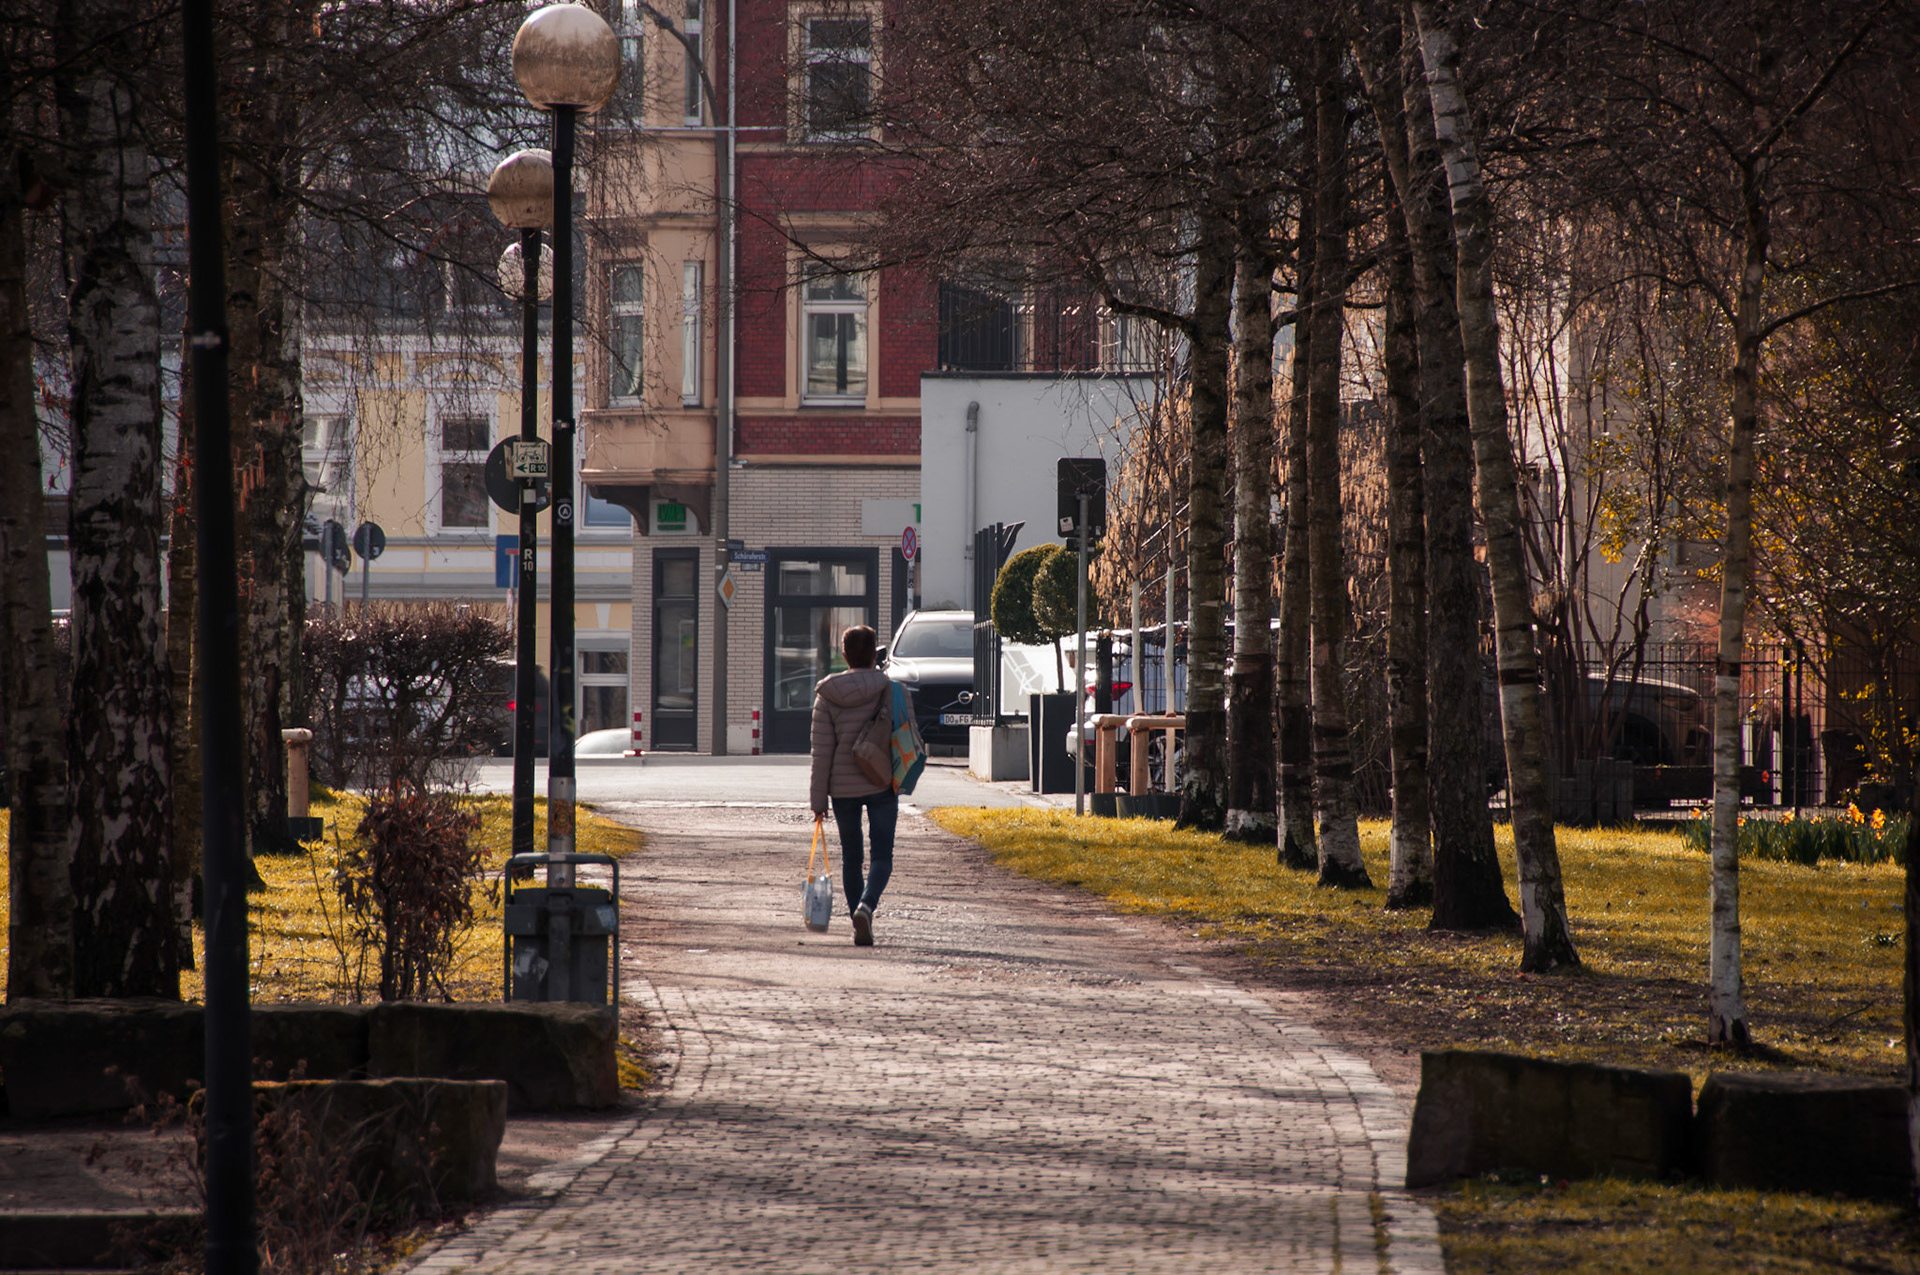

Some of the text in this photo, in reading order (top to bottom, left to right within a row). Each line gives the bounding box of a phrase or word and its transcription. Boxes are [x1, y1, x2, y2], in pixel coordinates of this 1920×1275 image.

[530, 464, 546, 473] R 10
[524, 548, 533, 560] R
[522, 561, 534, 571] 10
[945, 715, 955, 724] DO
